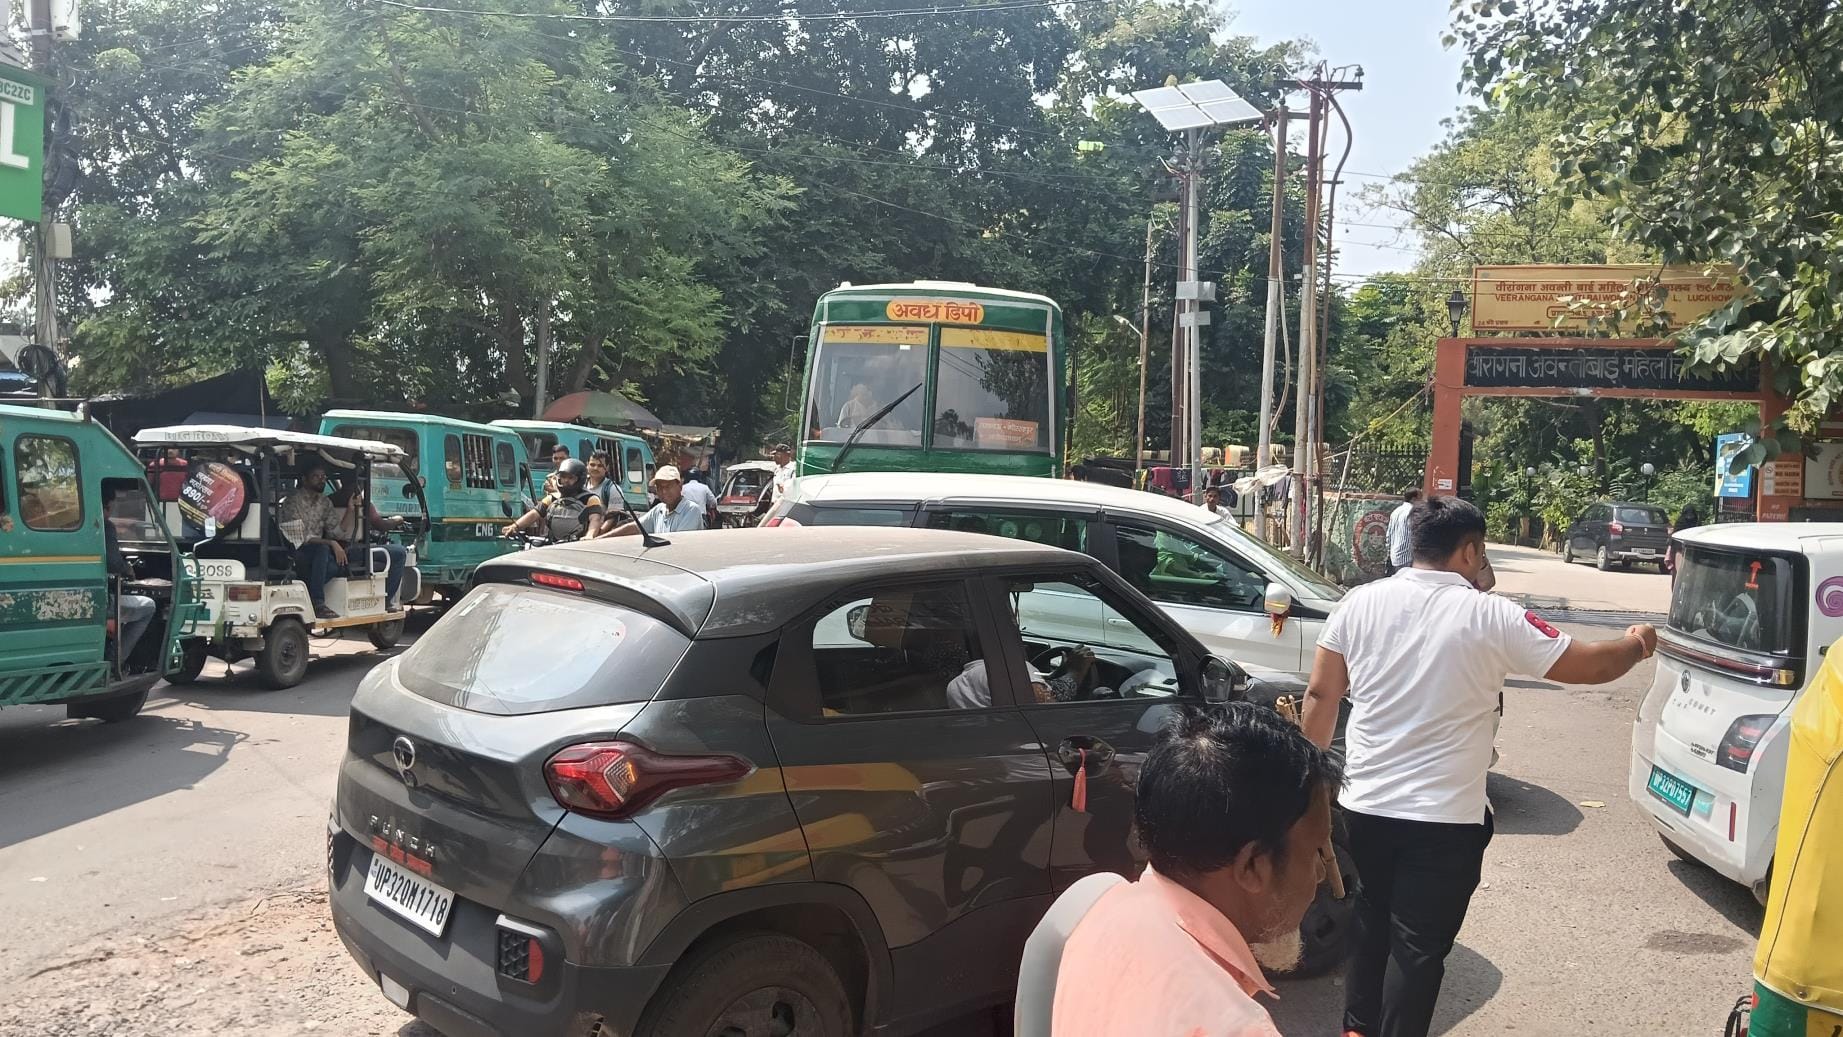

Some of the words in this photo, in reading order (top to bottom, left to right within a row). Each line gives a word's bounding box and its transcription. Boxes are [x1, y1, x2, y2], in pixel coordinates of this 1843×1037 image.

[1495, 294, 1554, 302] VEERANGANA
[1687, 294, 1732, 302] LUCKNOW
[892, 303, 940, 319] अवध
[475, 523, 494, 537] CNG
